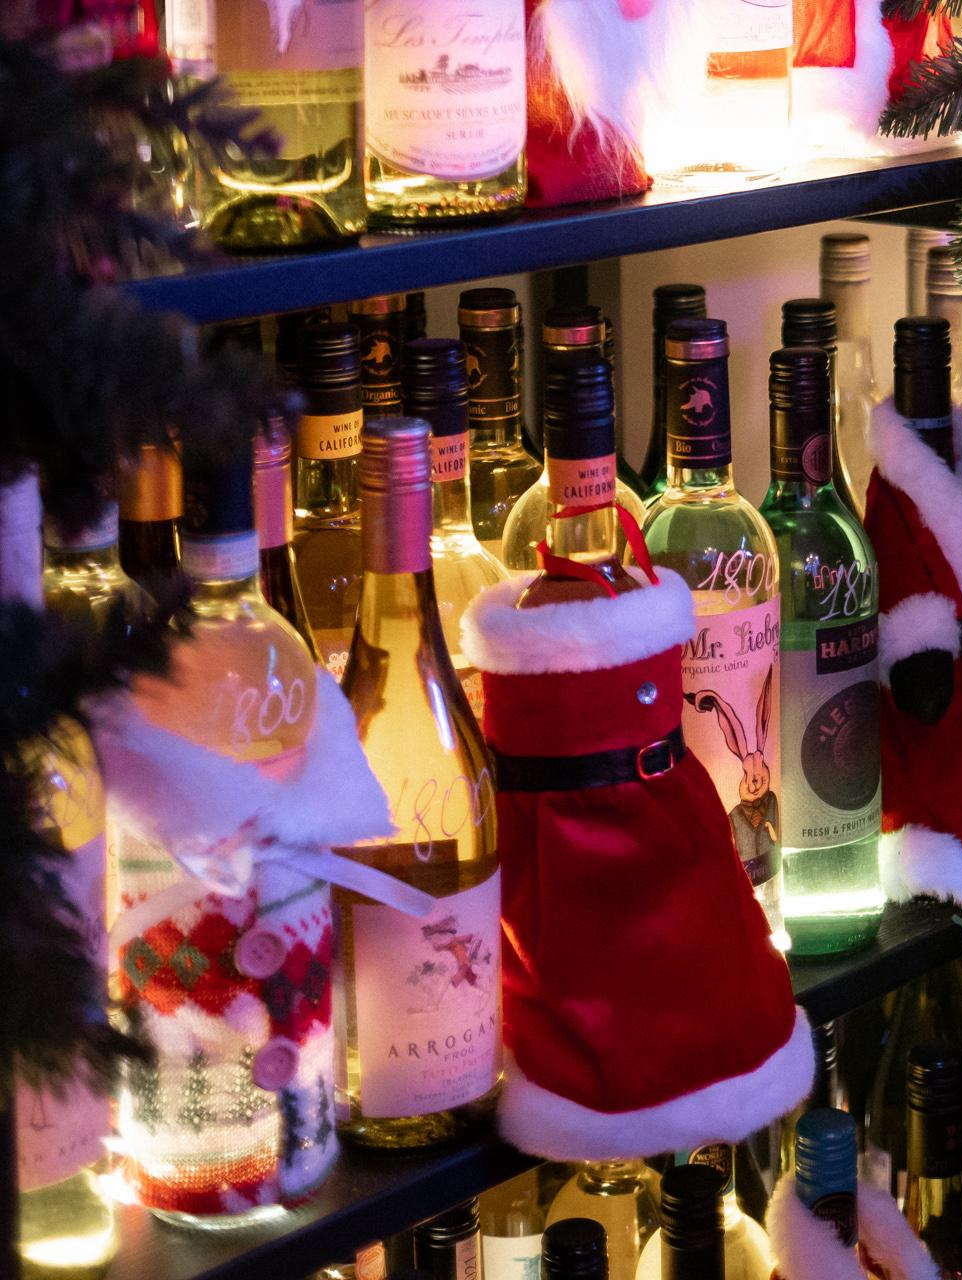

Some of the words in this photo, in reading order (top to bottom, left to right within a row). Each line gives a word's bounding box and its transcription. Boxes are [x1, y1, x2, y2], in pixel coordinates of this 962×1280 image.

[333, 422, 353, 434] WINE
[438, 444, 458, 456] WINE
[675, 440, 692, 453] Bio
[578, 468, 599, 479] WINE
[681, 627, 725, 661] Mr.
[725, 659, 749, 672] wine
[802, 827, 830, 838] FRESH
[833, 825, 839, 835] &
[842, 816, 867, 833] FRUITY
